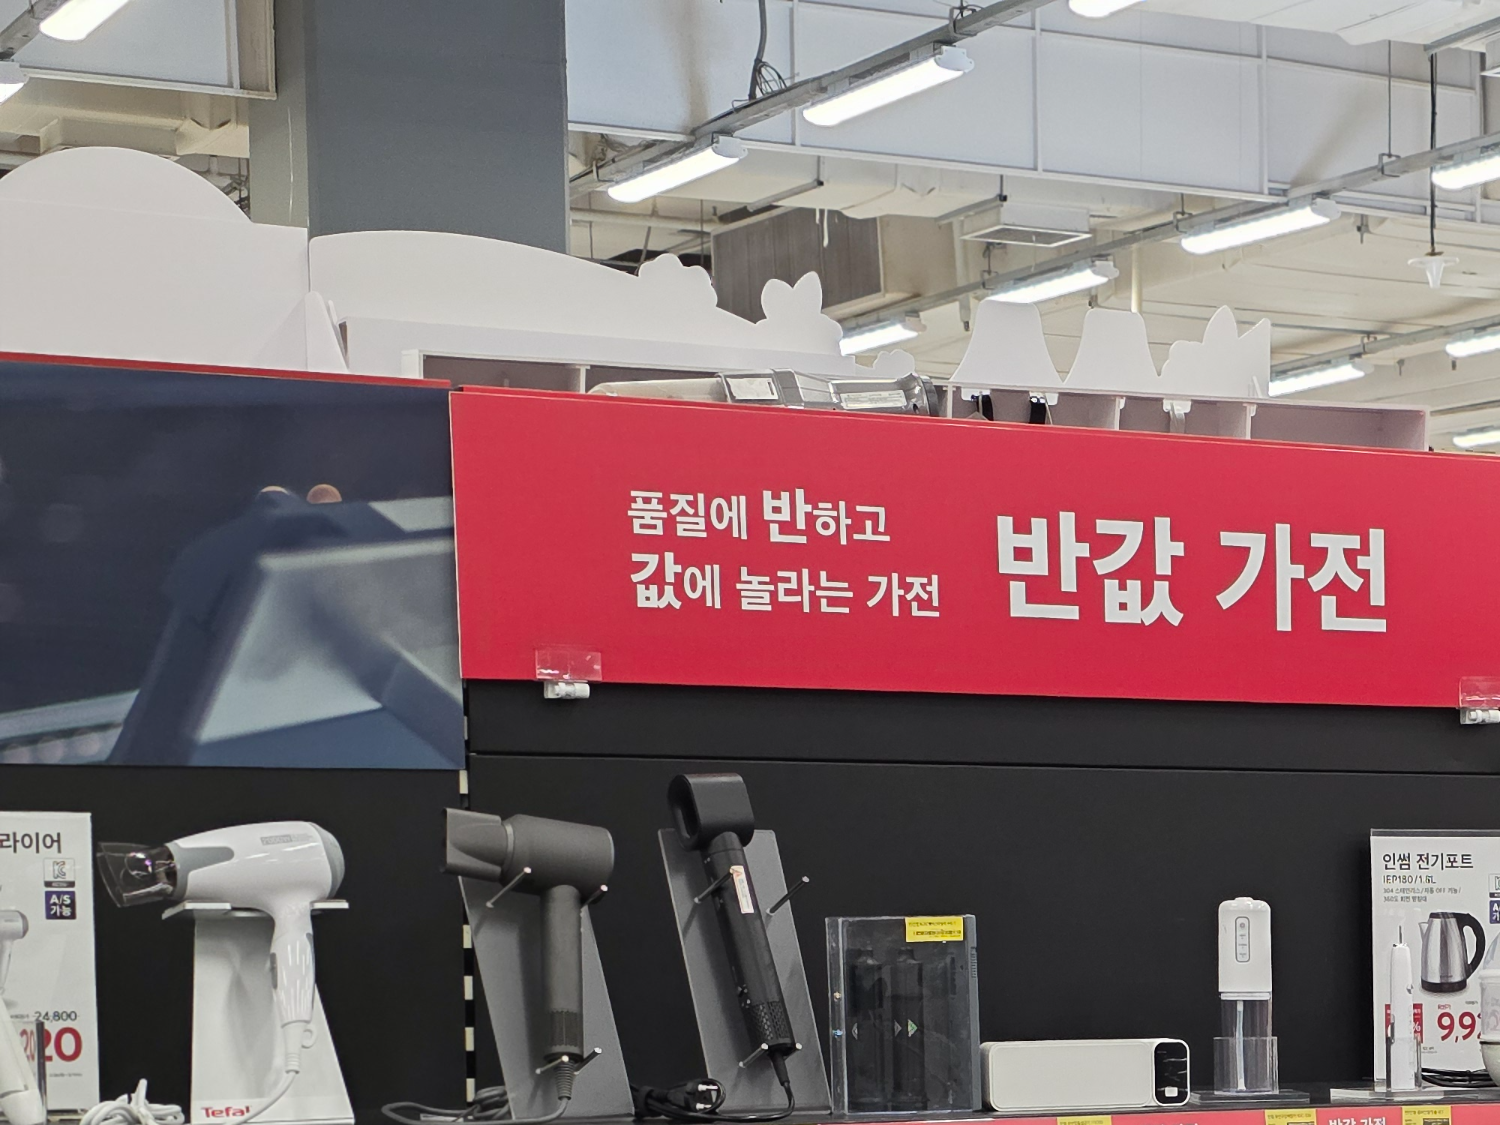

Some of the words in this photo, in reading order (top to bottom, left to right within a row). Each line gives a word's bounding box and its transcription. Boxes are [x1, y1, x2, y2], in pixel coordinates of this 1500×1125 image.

[628, 491, 747, 539] 품질에
[763, 489, 890, 544] 반하고
[998, 512, 1184, 626] 반값
[1216, 524, 1386, 632] 가전
[631, 552, 721, 609] 값에
[736, 567, 853, 613] 놀라는
[867, 573, 939, 616] 가전
[1383, 853, 1411, 870] 인썸
[1416, 853, 1473, 870] 전기포트
[49, 893, 71, 905] A/S
[49, 905, 72, 917] 가능
[202, 1106, 250, 1118] Tefal
